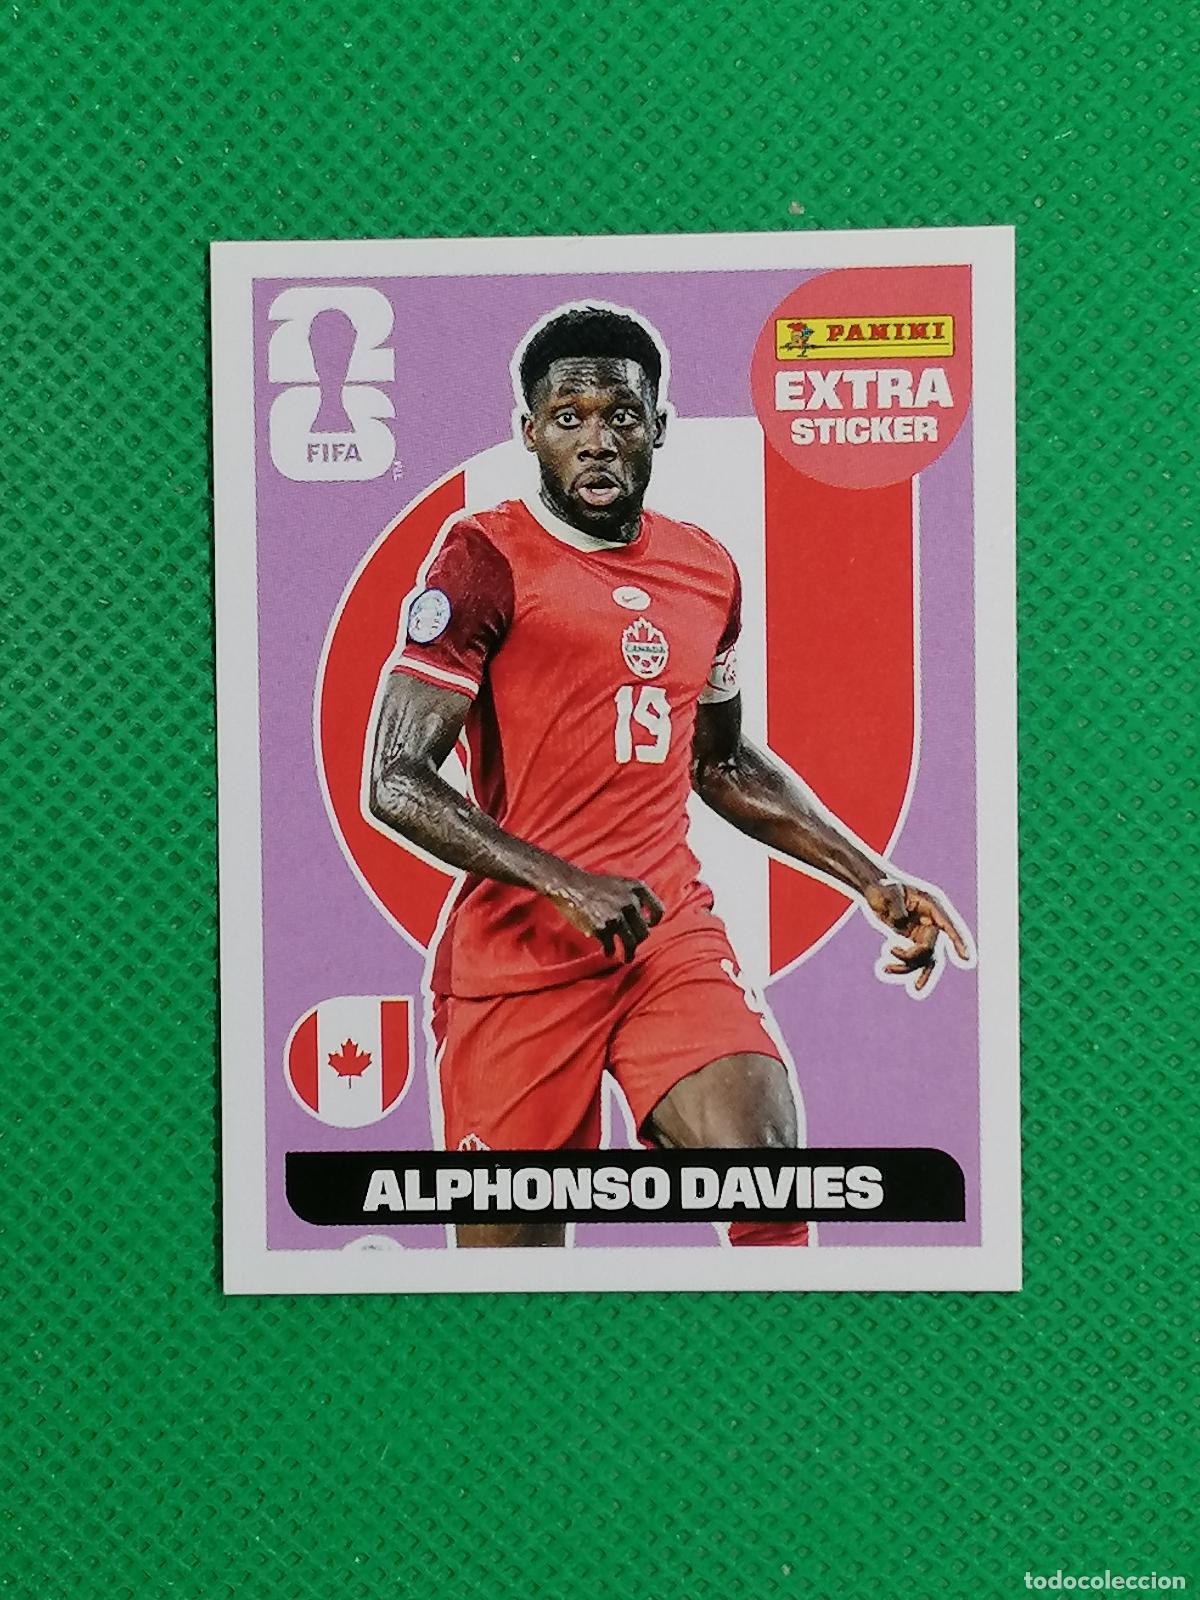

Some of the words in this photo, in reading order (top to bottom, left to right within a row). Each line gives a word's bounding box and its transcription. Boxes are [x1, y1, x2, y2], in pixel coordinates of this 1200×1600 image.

[826, 322, 946, 342] PANINI
[774, 368, 954, 411] EXTRA
[790, 416, 939, 445] STICKER
[307, 443, 362, 463] FIFA
[615, 685, 672, 763] 19
[363, 1167, 671, 1211] ALPHONSO
[681, 1165, 884, 1210] DAVIES
